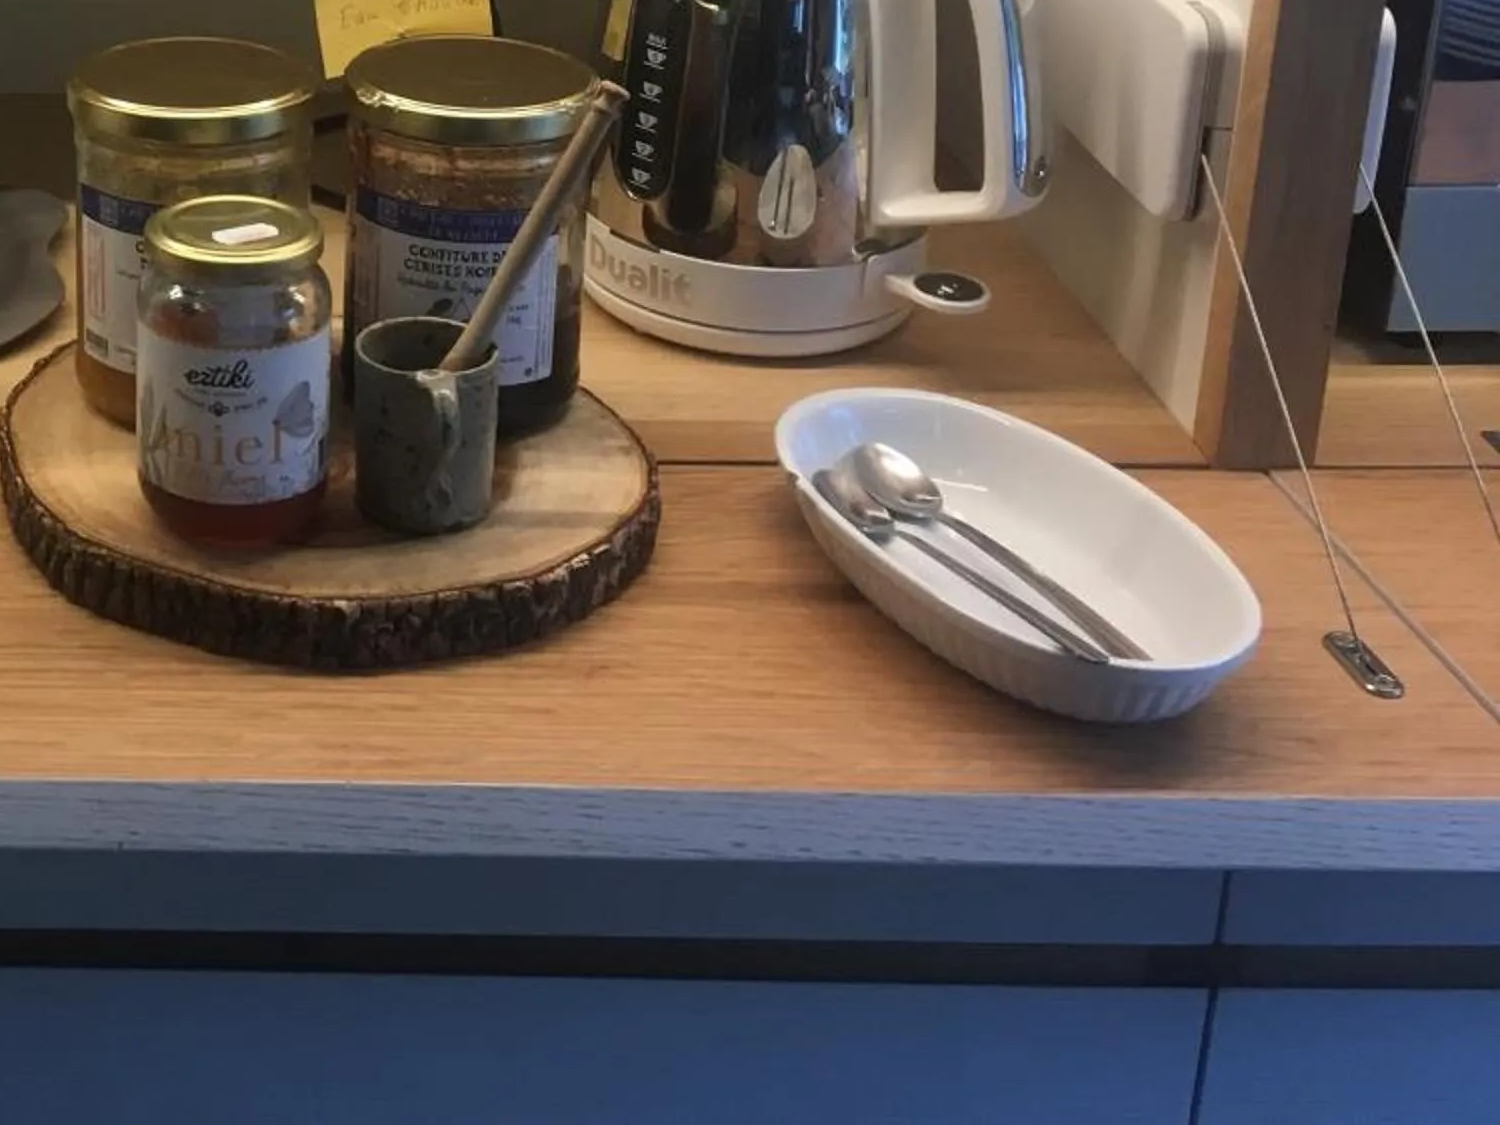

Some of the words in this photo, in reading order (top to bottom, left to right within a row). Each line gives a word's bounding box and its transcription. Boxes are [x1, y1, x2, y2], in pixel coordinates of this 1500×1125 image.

[408, 243, 489, 264] CONFITURE
[403, 257, 461, 277] CERISES
[589, 234, 692, 305] Dualit
